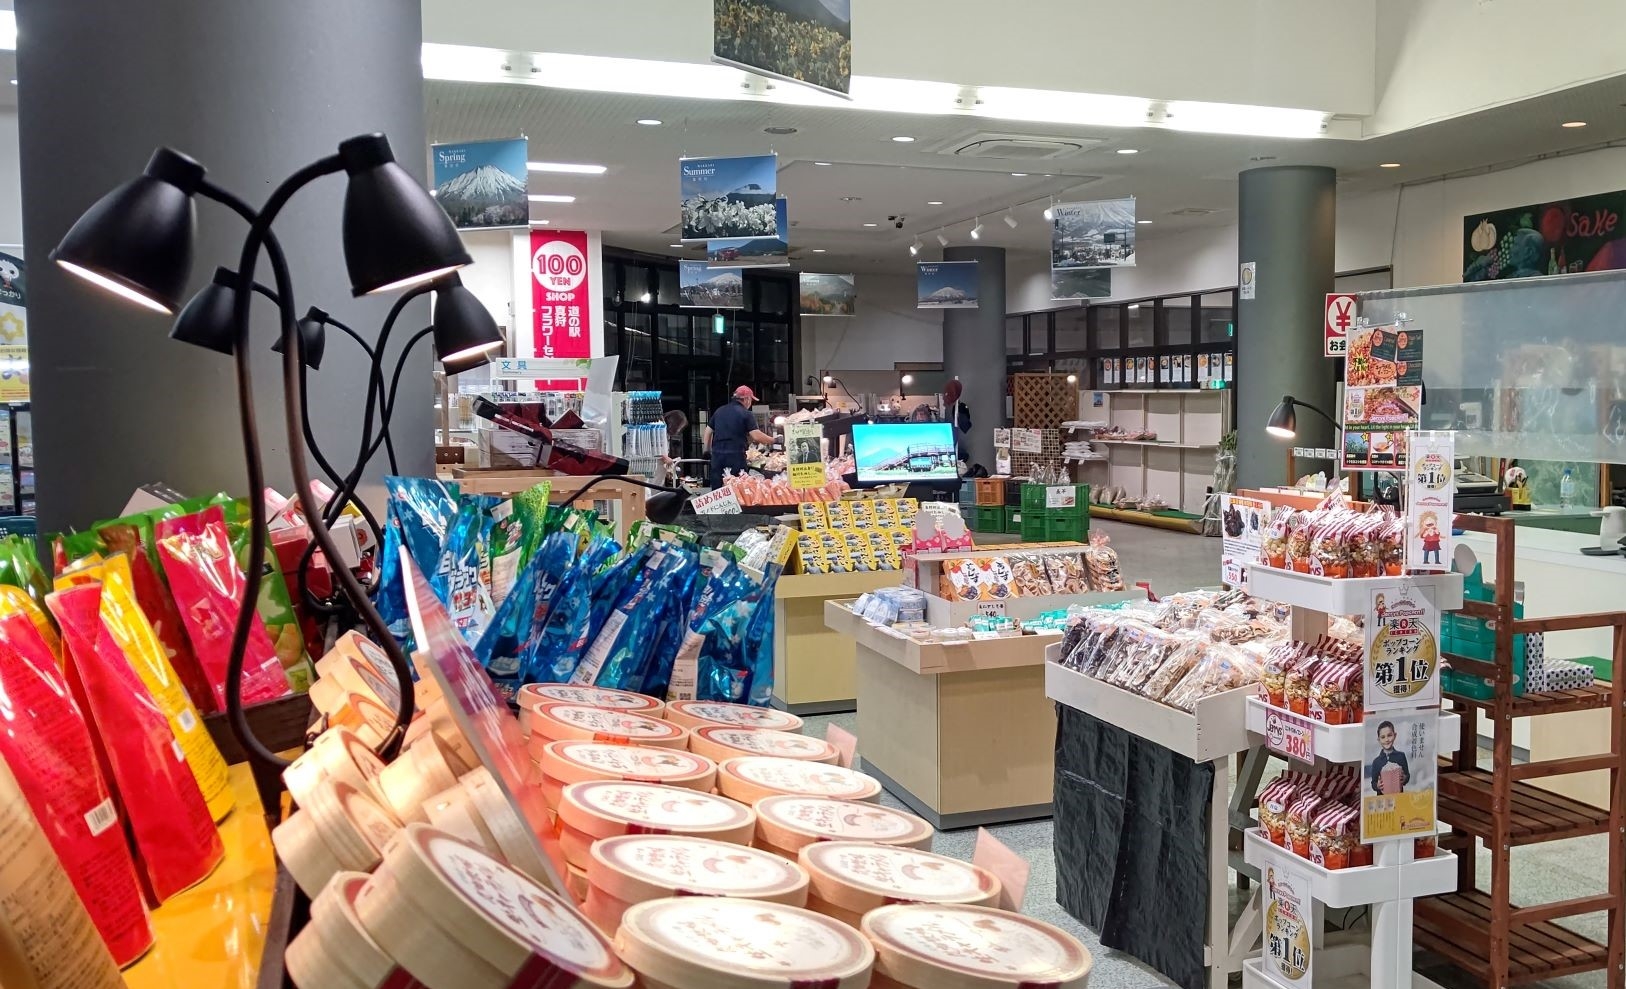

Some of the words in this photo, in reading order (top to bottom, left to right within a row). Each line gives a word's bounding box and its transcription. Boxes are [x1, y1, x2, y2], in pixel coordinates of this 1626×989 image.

[439, 151, 466, 164] Spring
[683, 166, 716, 176] Summer
[1057, 208, 1081, 217] Winter
[537, 254, 583, 276] 100
[549, 277, 571, 286] YEN
[545, 292, 576, 302] SHOP
[568, 306, 581, 338] 道の駅
[501, 361, 527, 370] 文具
[1383, 638, 1423, 647] ポップコーン
[1386, 646, 1419, 656] ランキング
[1375, 656, 1429, 684] 第1位
[1270, 934, 1305, 972] 第1位
